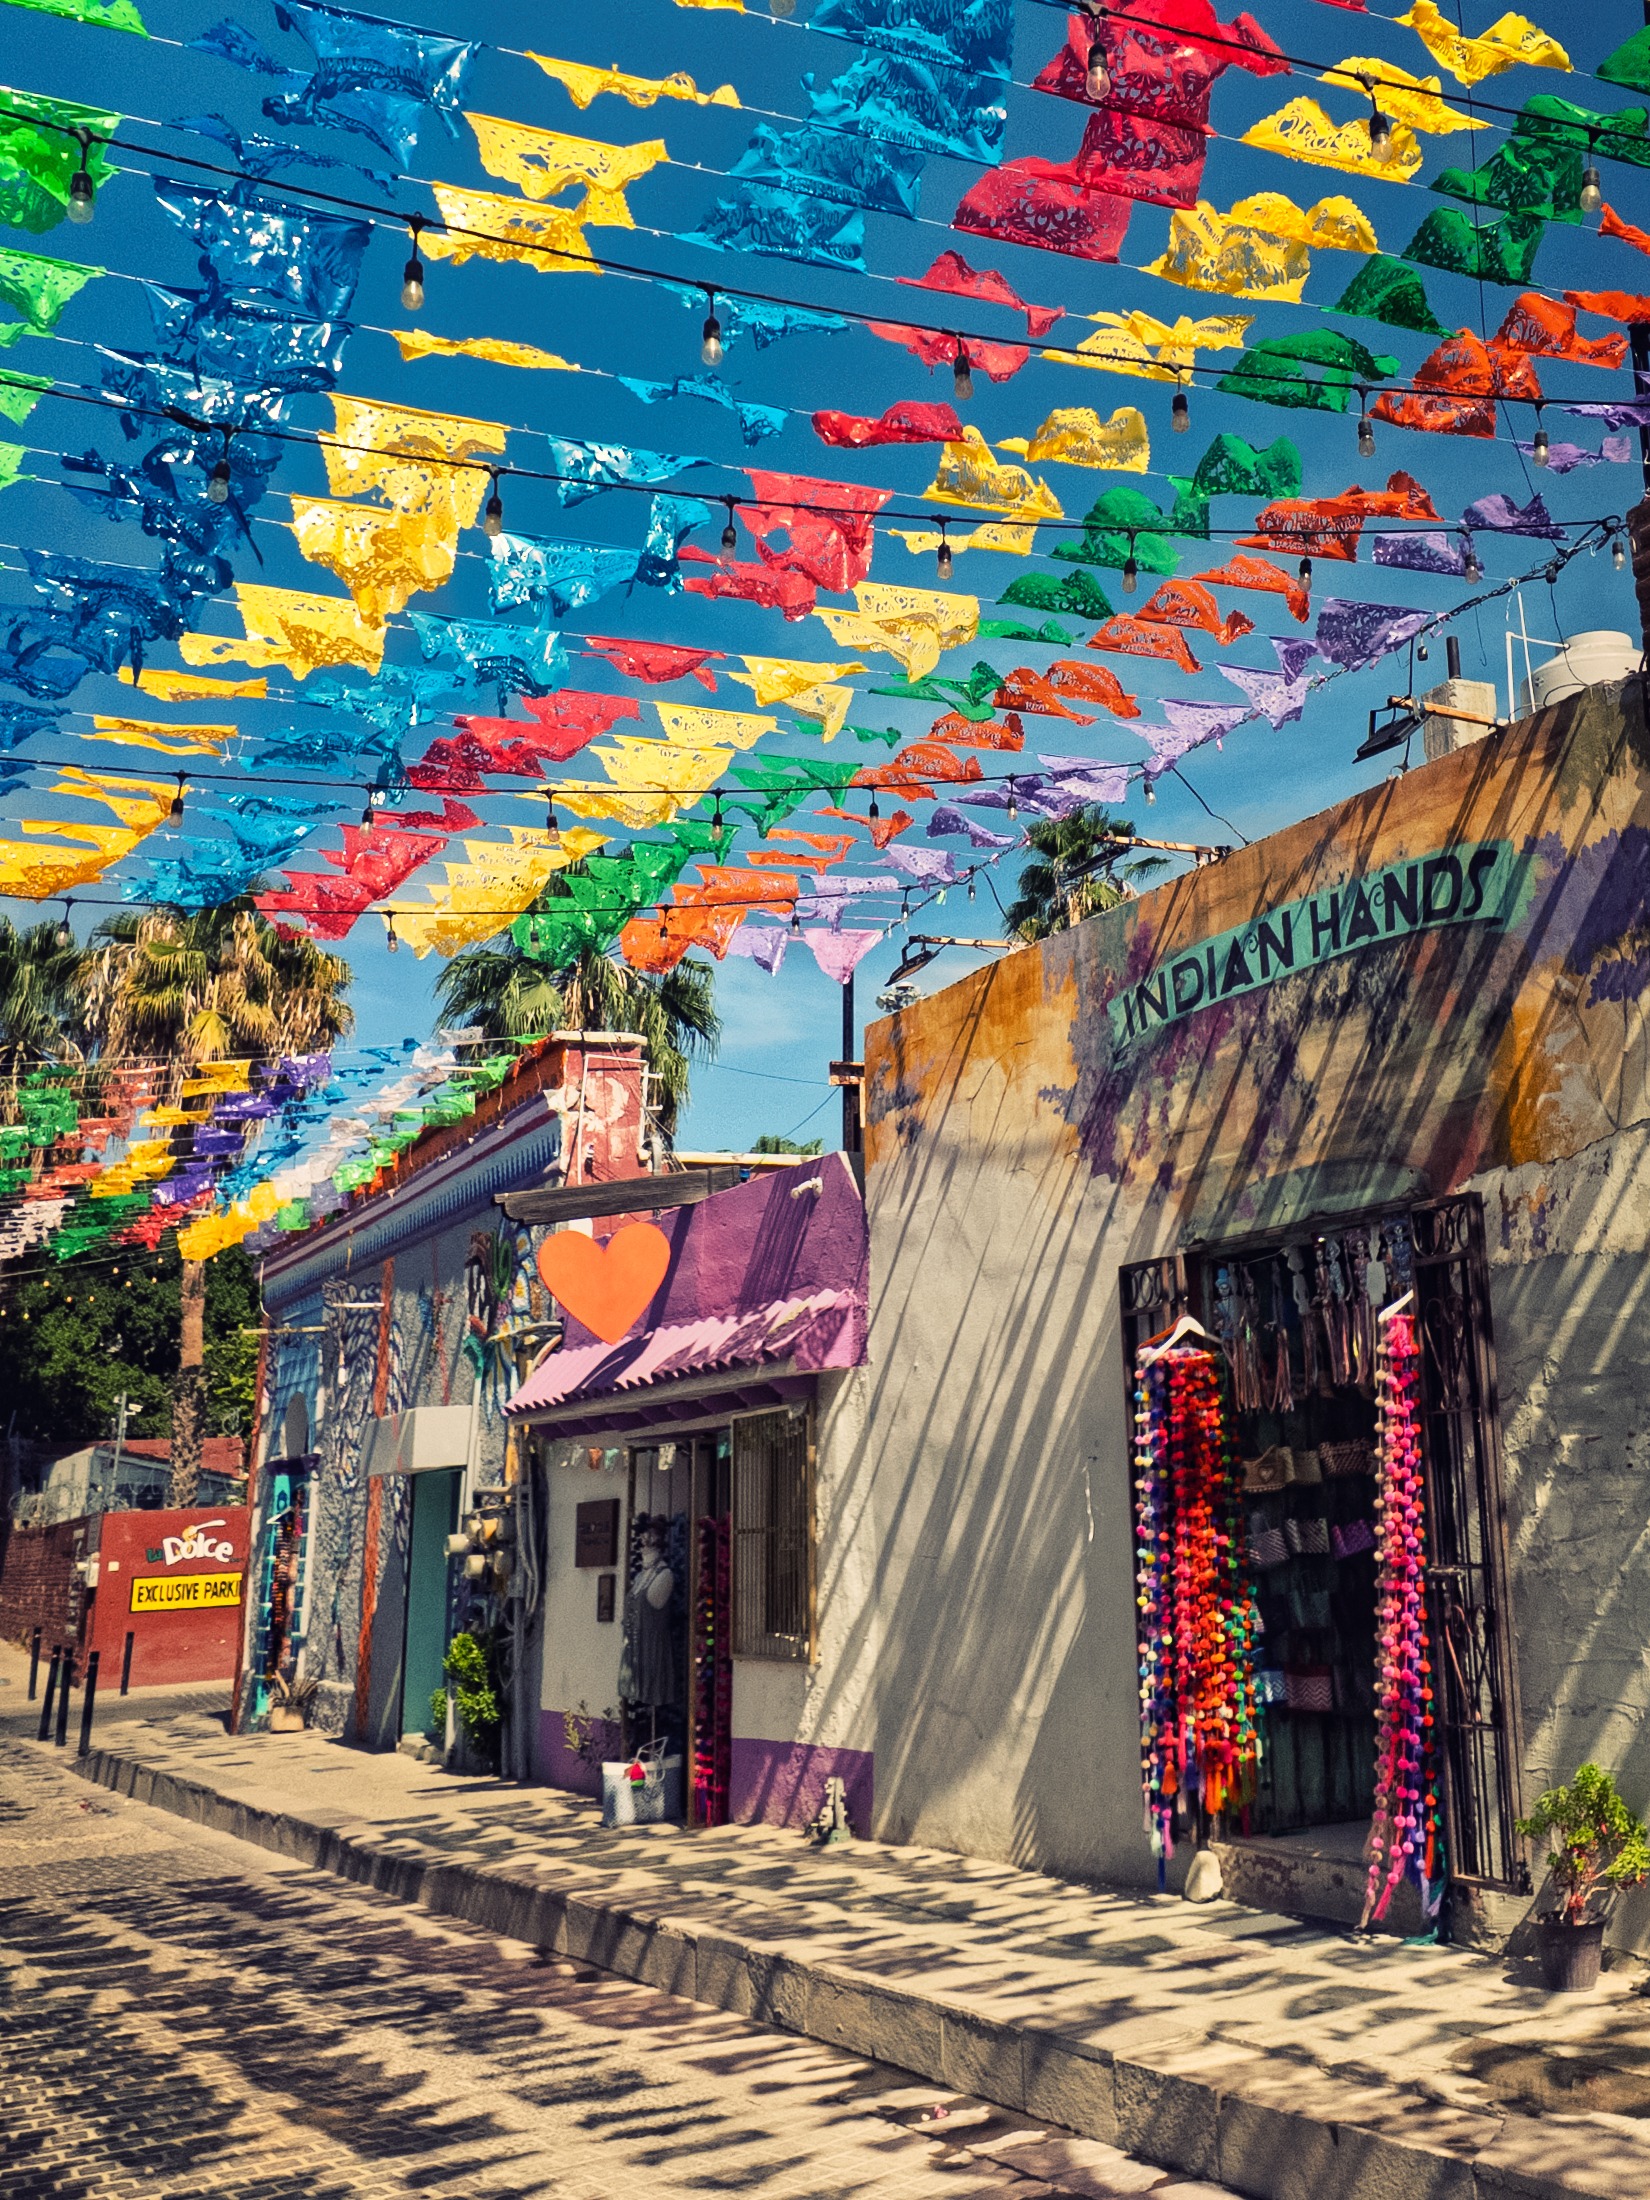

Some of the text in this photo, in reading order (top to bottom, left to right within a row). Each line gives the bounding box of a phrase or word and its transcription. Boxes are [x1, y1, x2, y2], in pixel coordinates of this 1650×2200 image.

[1122, 848, 1501, 1037] INDIAN HANDS
[162, 1532, 234, 1566] Dolce
[137, 1580, 241, 1603] EXCLUSIVE PARKI
